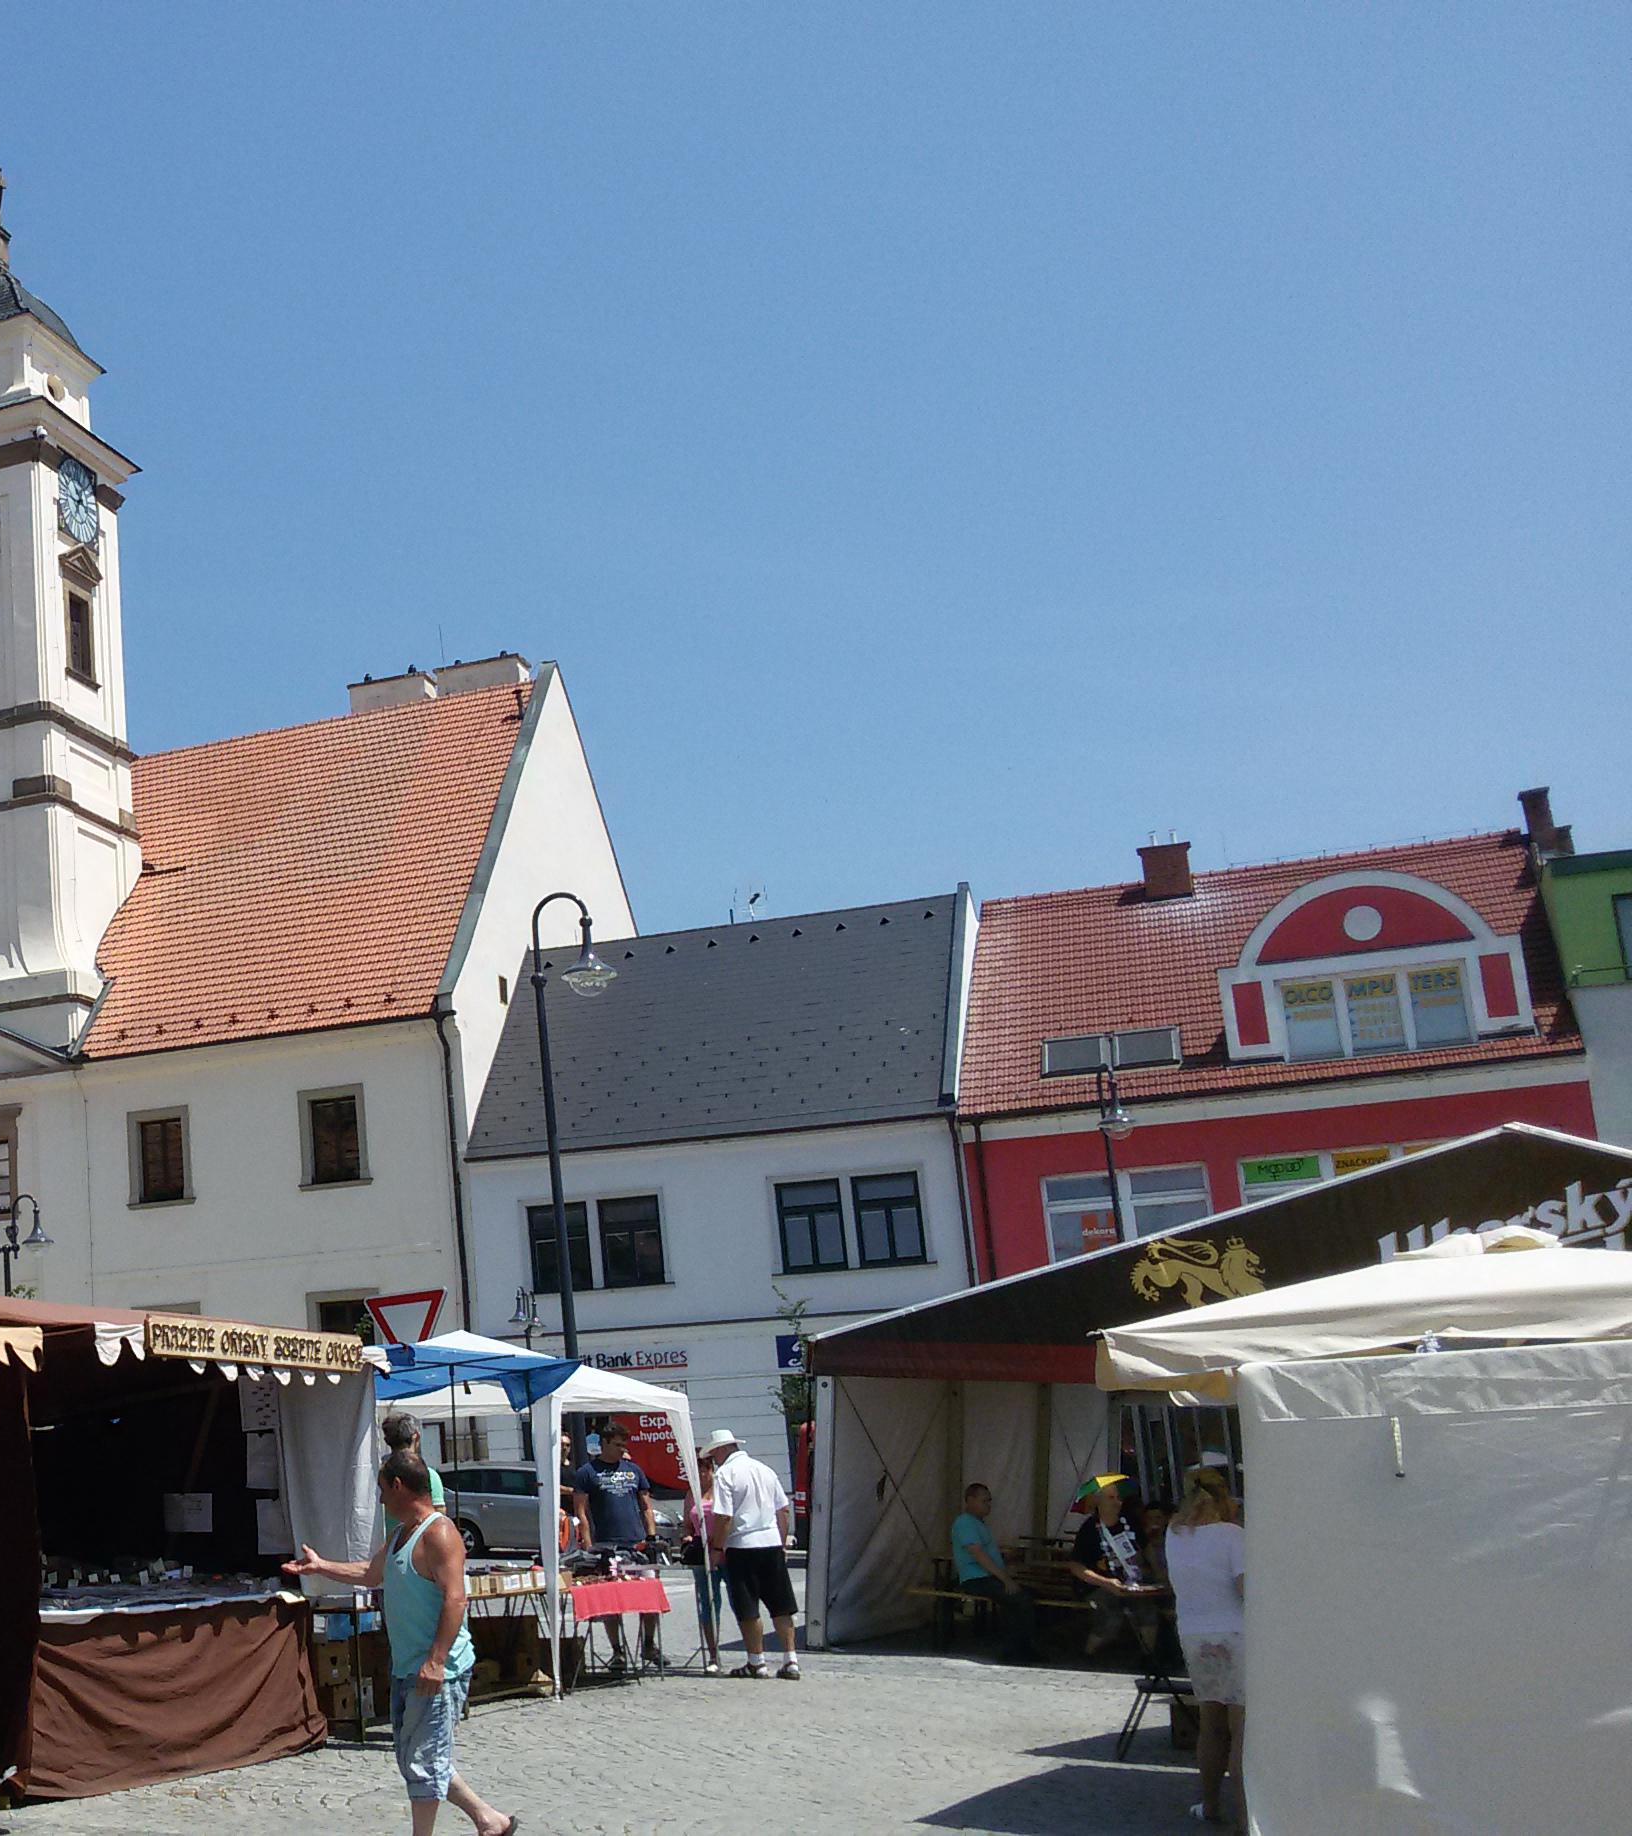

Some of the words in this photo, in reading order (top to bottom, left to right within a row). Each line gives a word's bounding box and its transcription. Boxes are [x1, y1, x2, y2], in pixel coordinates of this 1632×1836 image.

[1413, 972, 1458, 990] TERS
[596, 1351, 633, 1368] Bank
[636, 1350, 688, 1369] Expres
[666, 1442, 675, 1453] a
